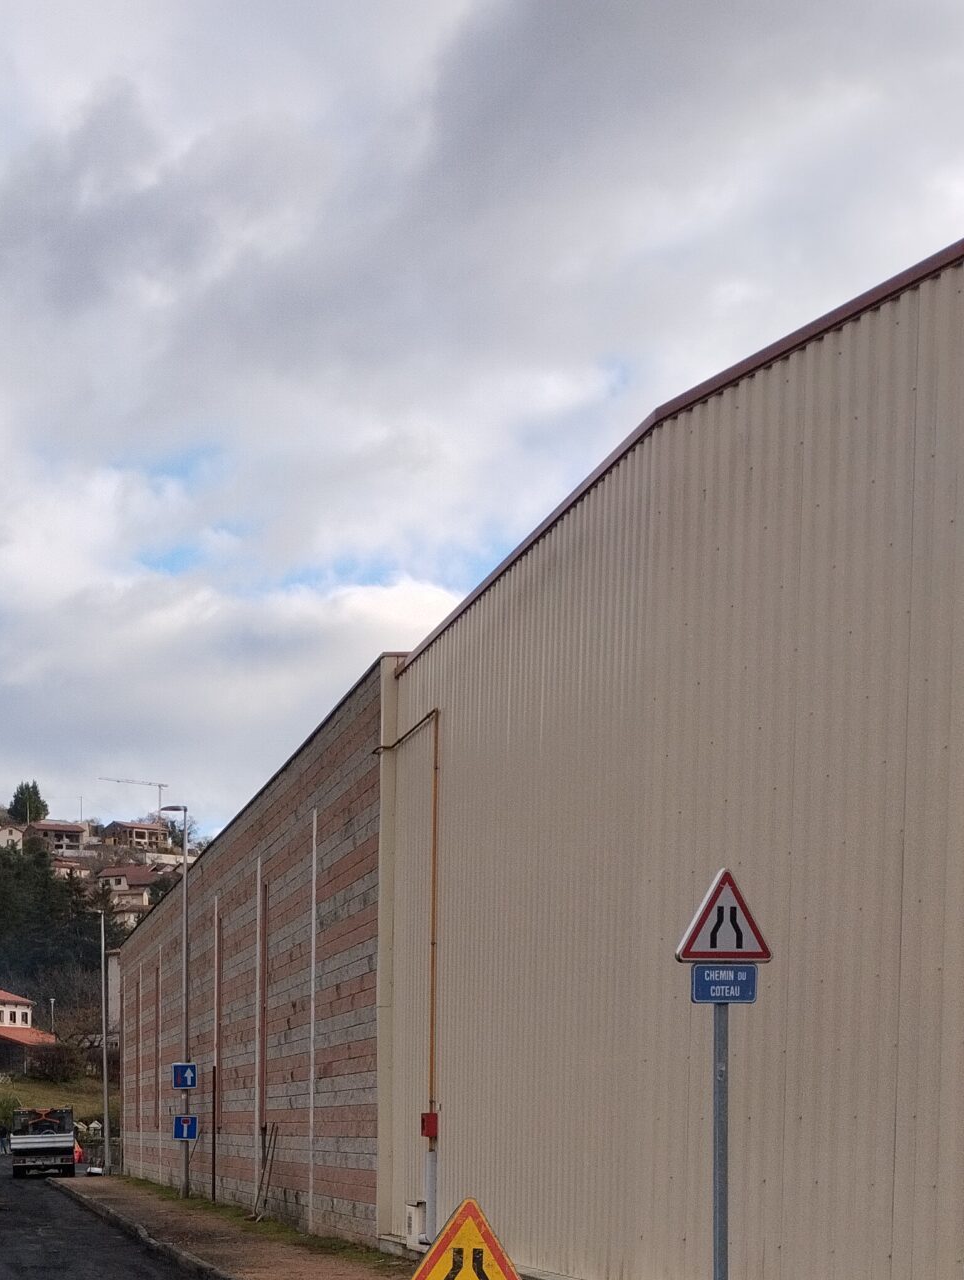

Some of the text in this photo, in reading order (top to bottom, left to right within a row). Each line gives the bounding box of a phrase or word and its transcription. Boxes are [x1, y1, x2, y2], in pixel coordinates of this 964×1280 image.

[704, 970, 747, 981] CHEMIN DU
[710, 985, 740, 997] COTEAU
